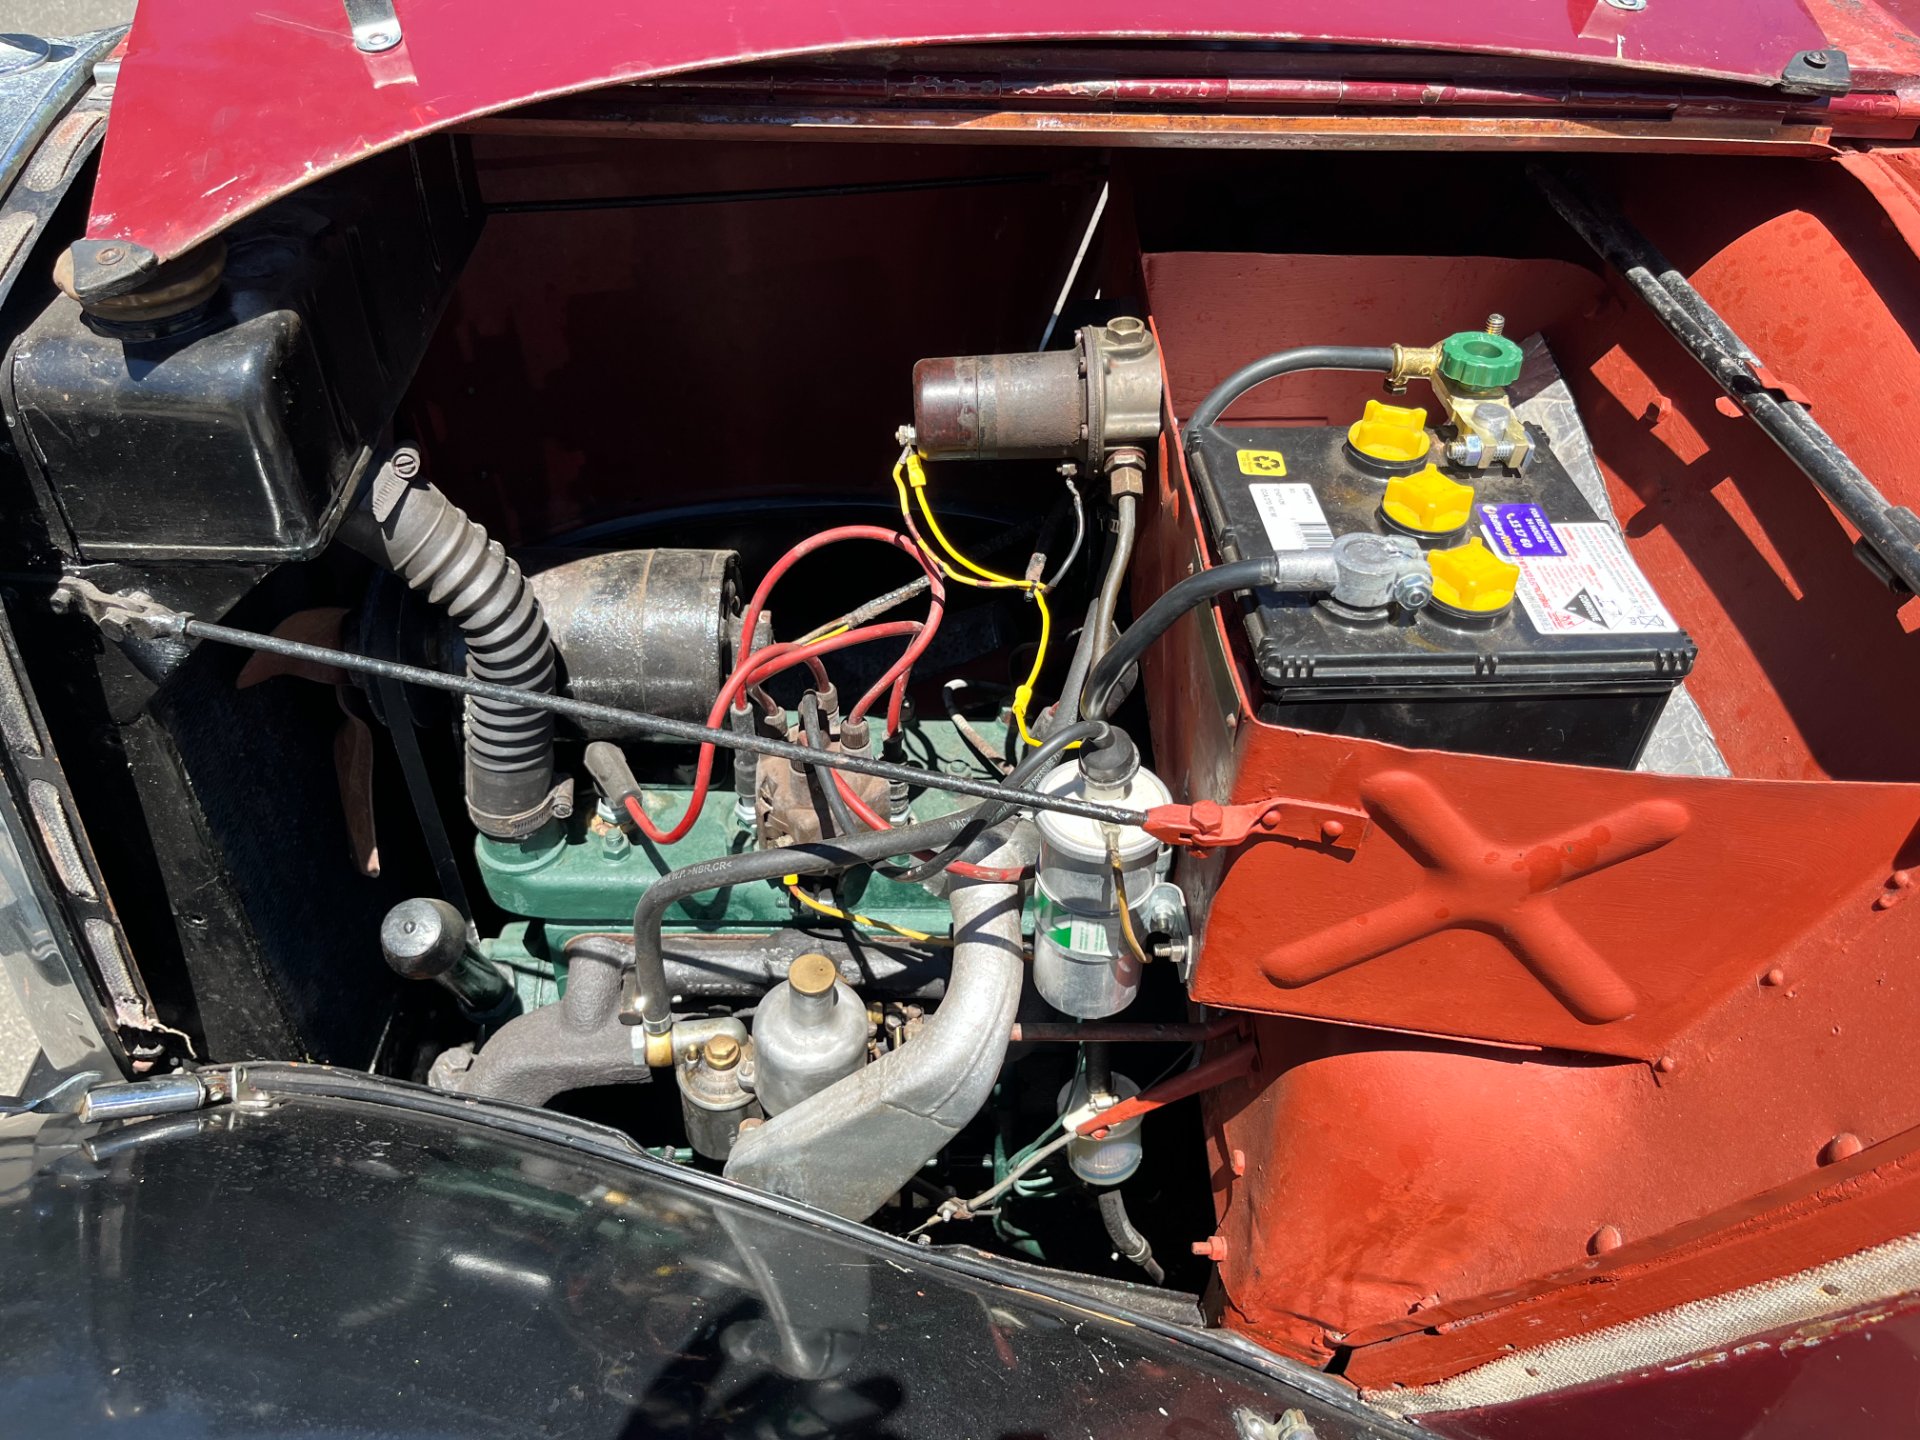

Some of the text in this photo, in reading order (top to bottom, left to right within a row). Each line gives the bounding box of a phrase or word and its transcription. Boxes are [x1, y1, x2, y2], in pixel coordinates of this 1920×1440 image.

[1514, 528, 1527, 540] 17
[1529, 507, 1539, 518] FOR
[1535, 516, 1562, 554] REPLACEMENT
[1529, 524, 1545, 544] HOURS
[1578, 594, 1602, 623] CORROSIVE
